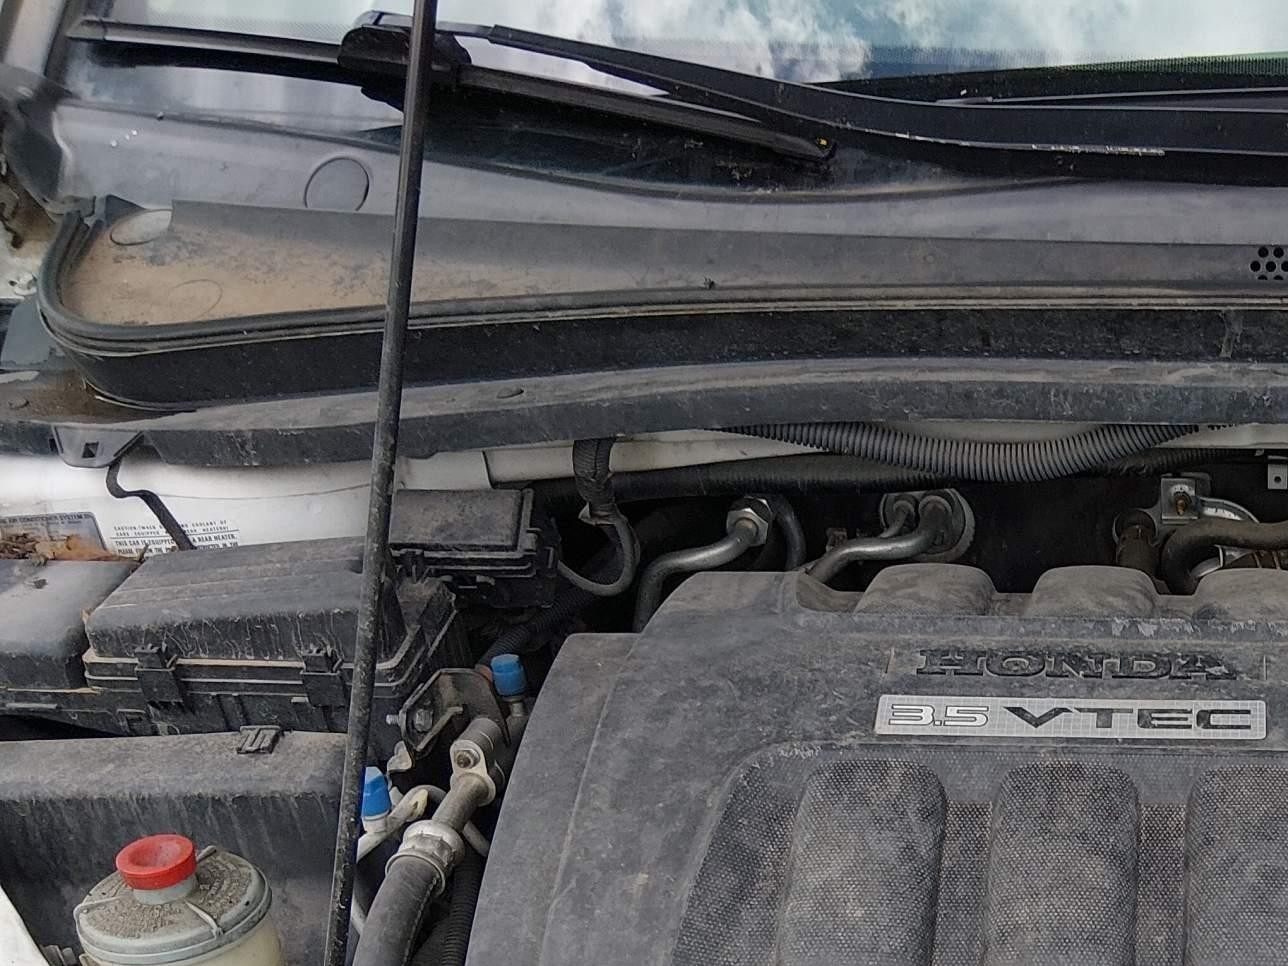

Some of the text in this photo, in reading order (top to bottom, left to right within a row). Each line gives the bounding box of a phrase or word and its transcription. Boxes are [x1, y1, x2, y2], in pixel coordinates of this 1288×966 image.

[916, 649, 1237, 681] HONDA
[889, 704, 1252, 730] 3.5 VTEC
